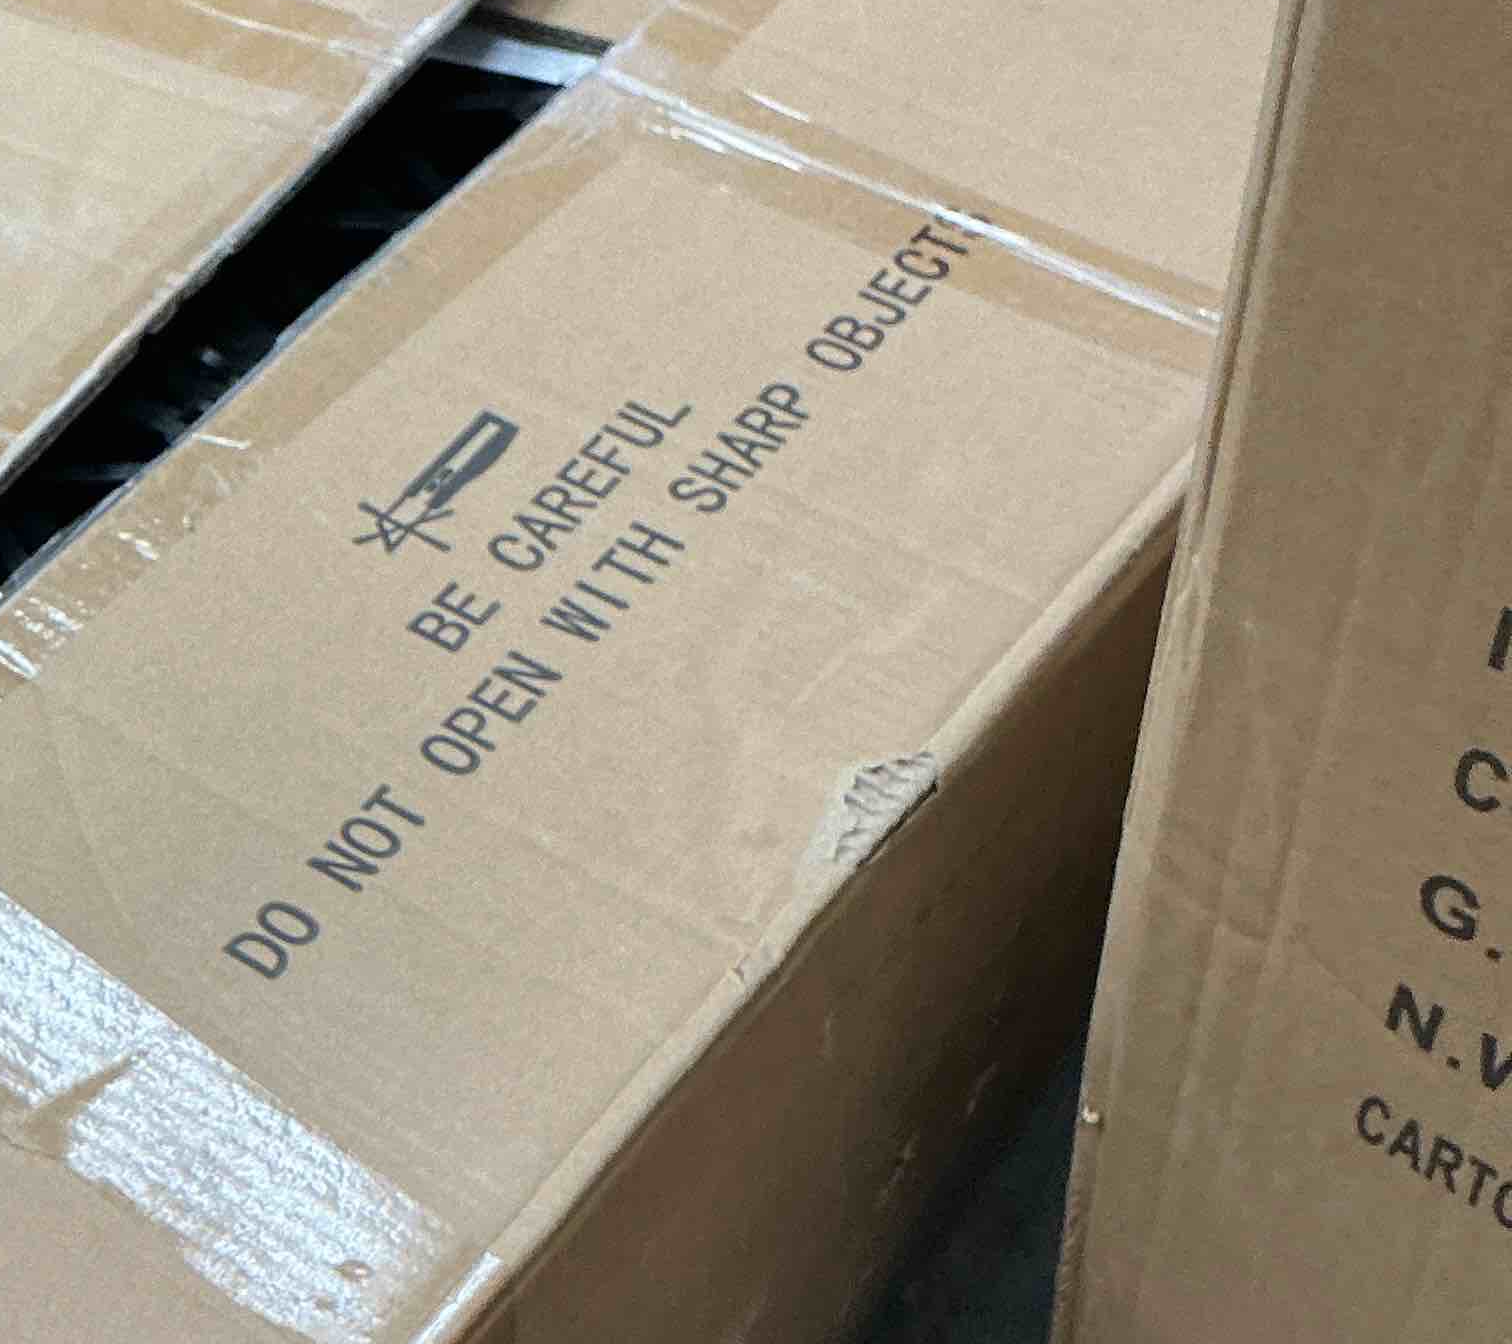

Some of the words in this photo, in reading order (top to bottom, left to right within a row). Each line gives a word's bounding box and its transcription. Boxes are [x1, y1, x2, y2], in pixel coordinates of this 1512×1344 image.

[223, 900, 322, 981] DO
[306, 782, 426, 894] NOT
[420, 649, 563, 777] OPEN
[540, 519, 686, 643] WITH
[668, 381, 811, 514] SHARP
[407, 581, 502, 654] BE
[489, 400, 695, 574] CAREFUL
